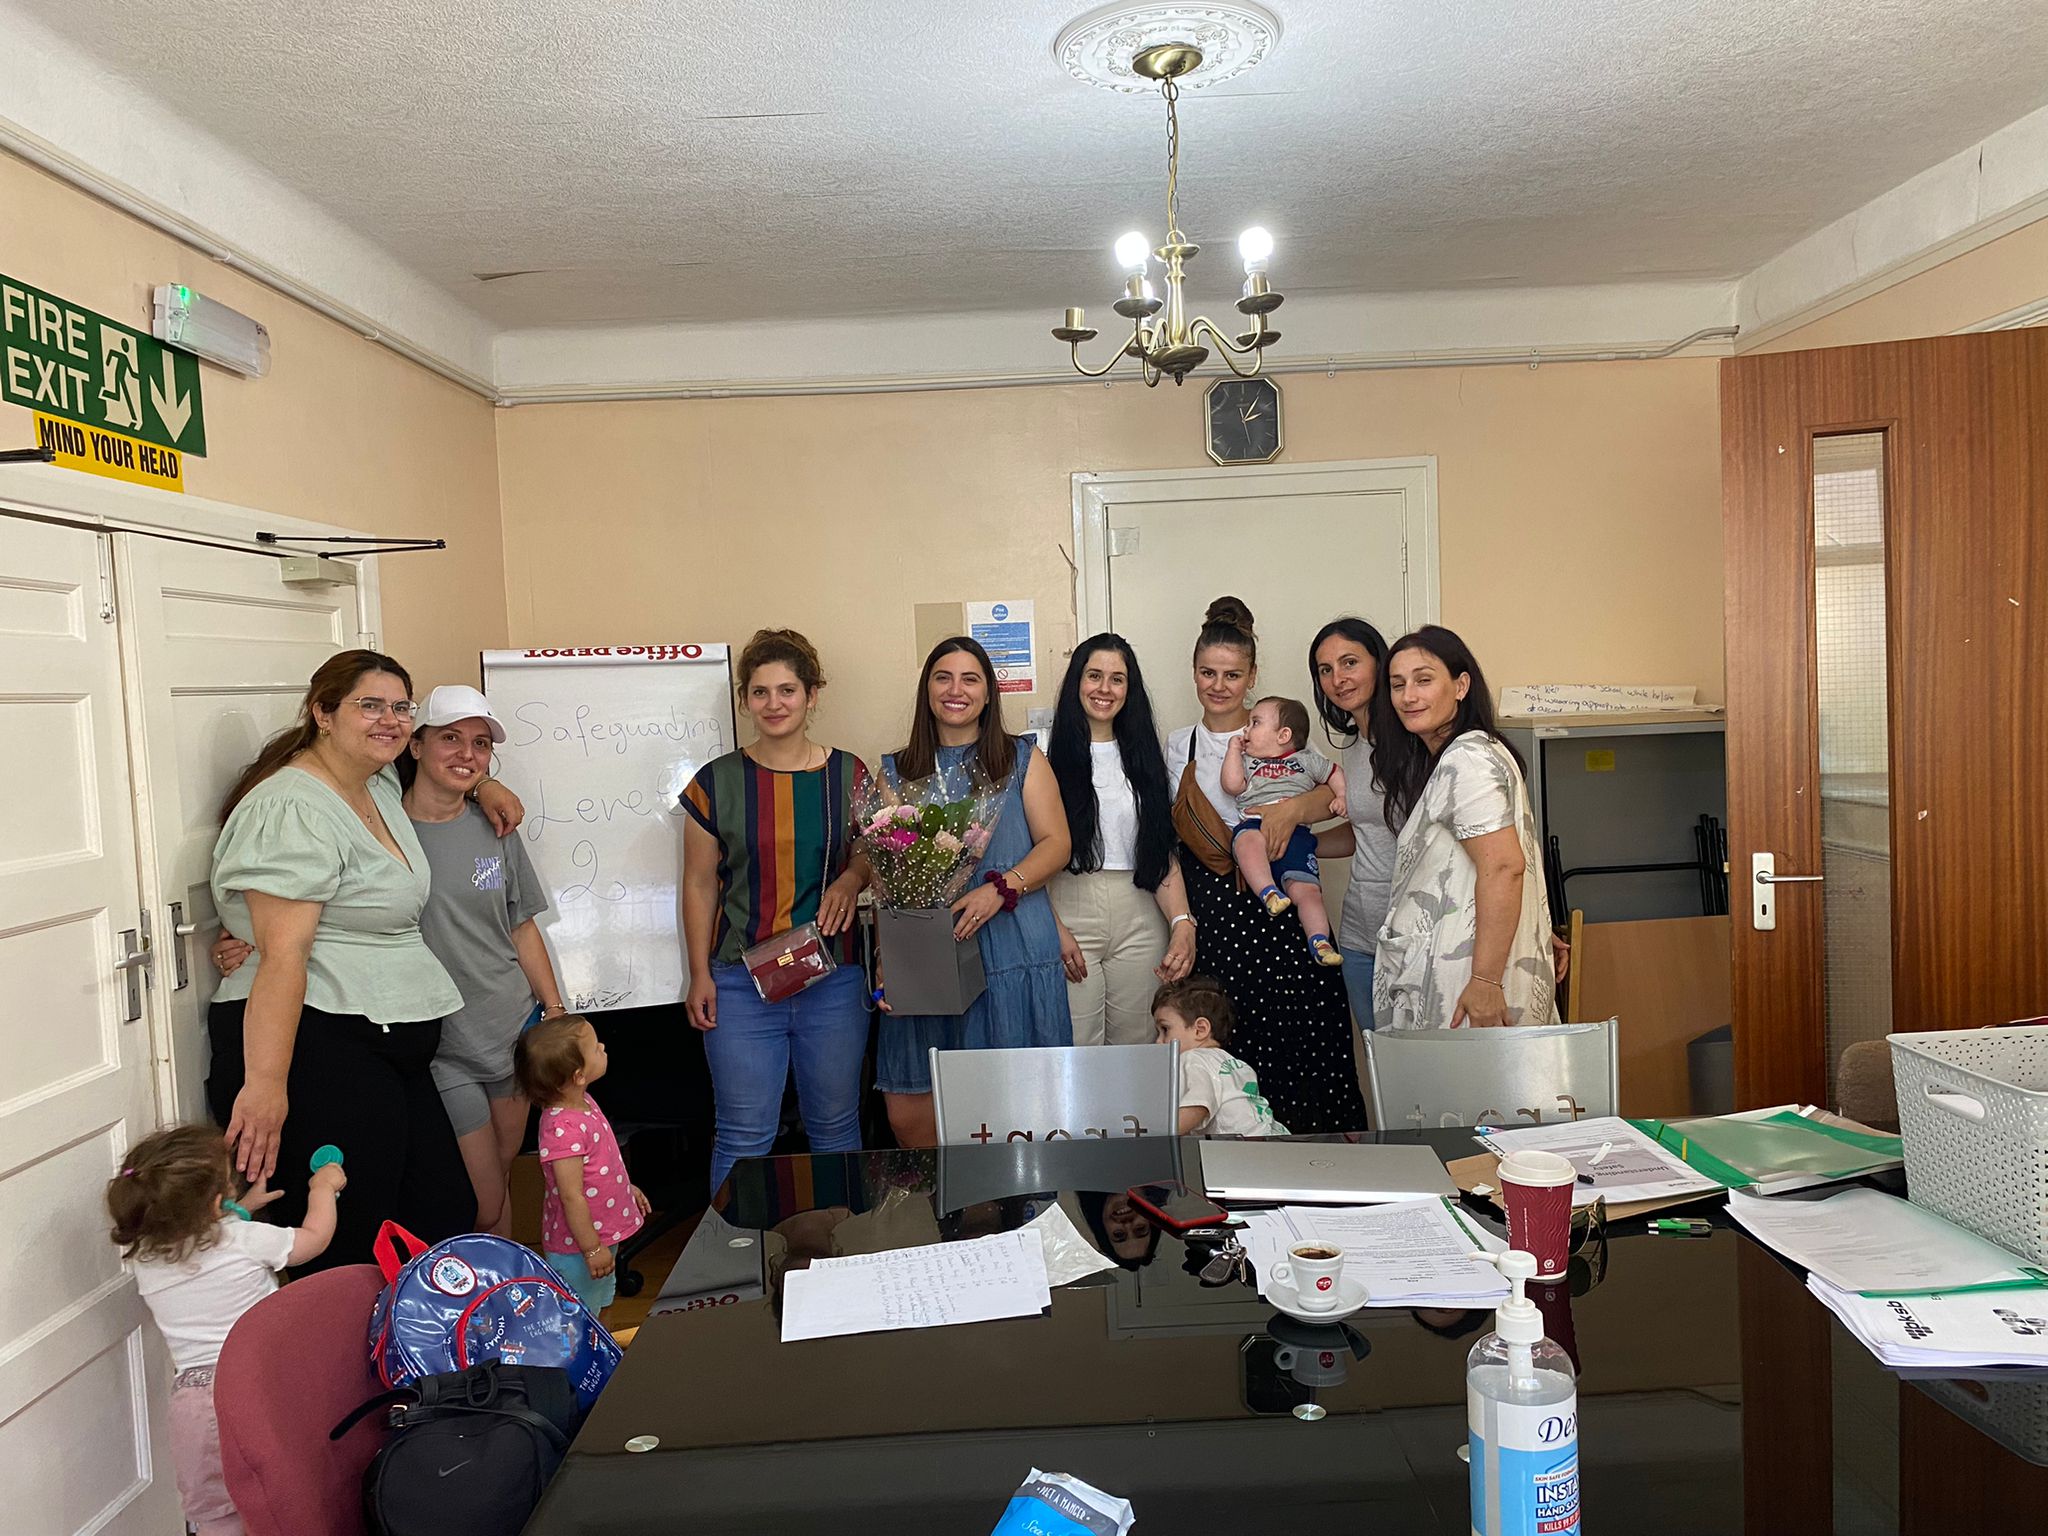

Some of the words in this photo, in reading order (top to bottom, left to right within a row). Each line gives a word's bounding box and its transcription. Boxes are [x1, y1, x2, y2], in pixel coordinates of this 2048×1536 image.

[2, 283, 89, 360] FIRE
[7, 345, 90, 415] EXIT
[39, 418, 86, 457] MIND
[90, 431, 135, 470] YOUR
[138, 444, 179, 479] HEAD
[524, 647, 611, 658] DEPOT
[616, 644, 703, 660] Office
[484, 1315, 506, 1351] THOMAS
[1537, 1505, 1566, 1518] HAND
[1544, 1520, 1562, 1532] KILLS
